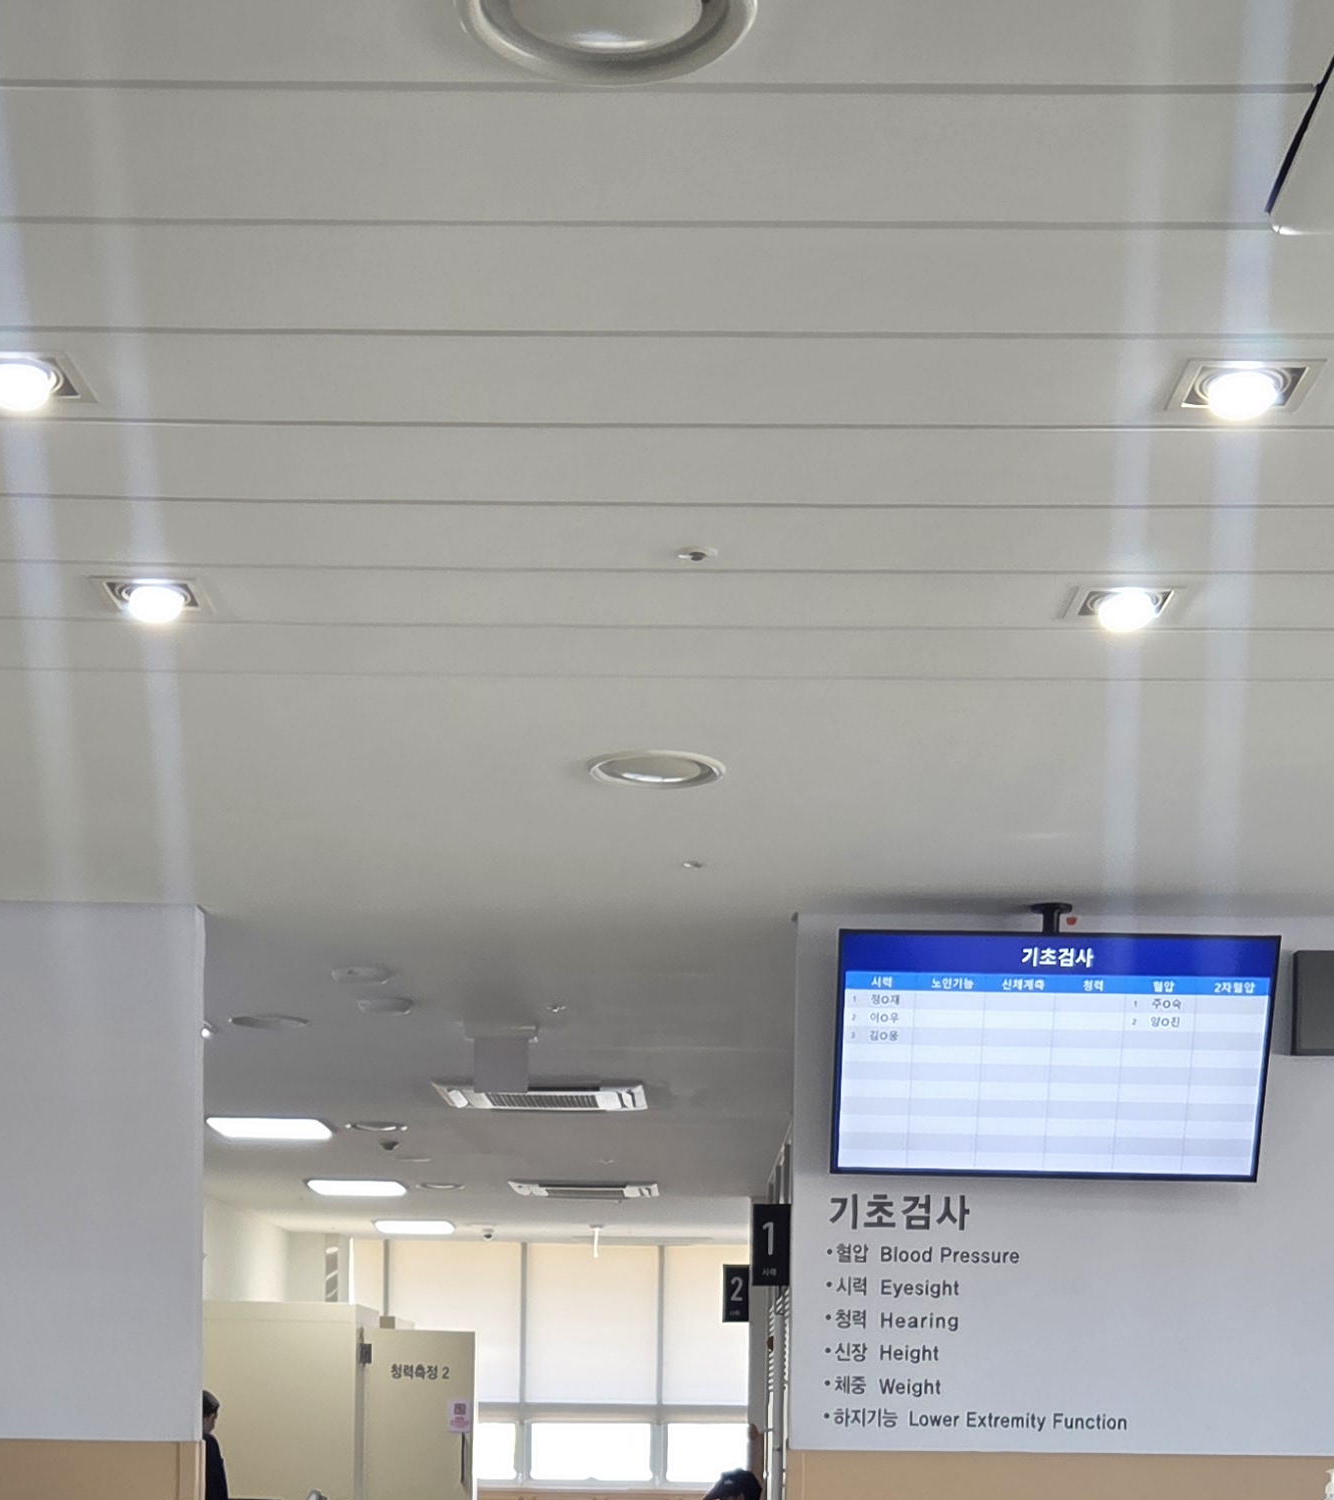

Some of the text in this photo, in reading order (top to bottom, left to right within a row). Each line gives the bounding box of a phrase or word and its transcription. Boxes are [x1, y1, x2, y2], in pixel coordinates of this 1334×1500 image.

[1021, 946, 1095, 968] 기초검사
[871, 976, 893, 989] 시력
[828, 1193, 970, 1231] 기초검사
[762, 1221, 774, 1256] 1
[836, 1243, 1020, 1264] 혈압 Blood Pressure
[730, 1276, 743, 1302] 2
[836, 1276, 960, 1298] 시력 Eyesight
[835, 1309, 959, 1331] 청력 Hearing
[834, 1342, 939, 1363] 신장 Height
[391, 1363, 450, 1380] 청력측정 2
[834, 1375, 942, 1397] 체중 Weight
[833, 1407, 1128, 1431] 하지기능 Lower Extremity Function
